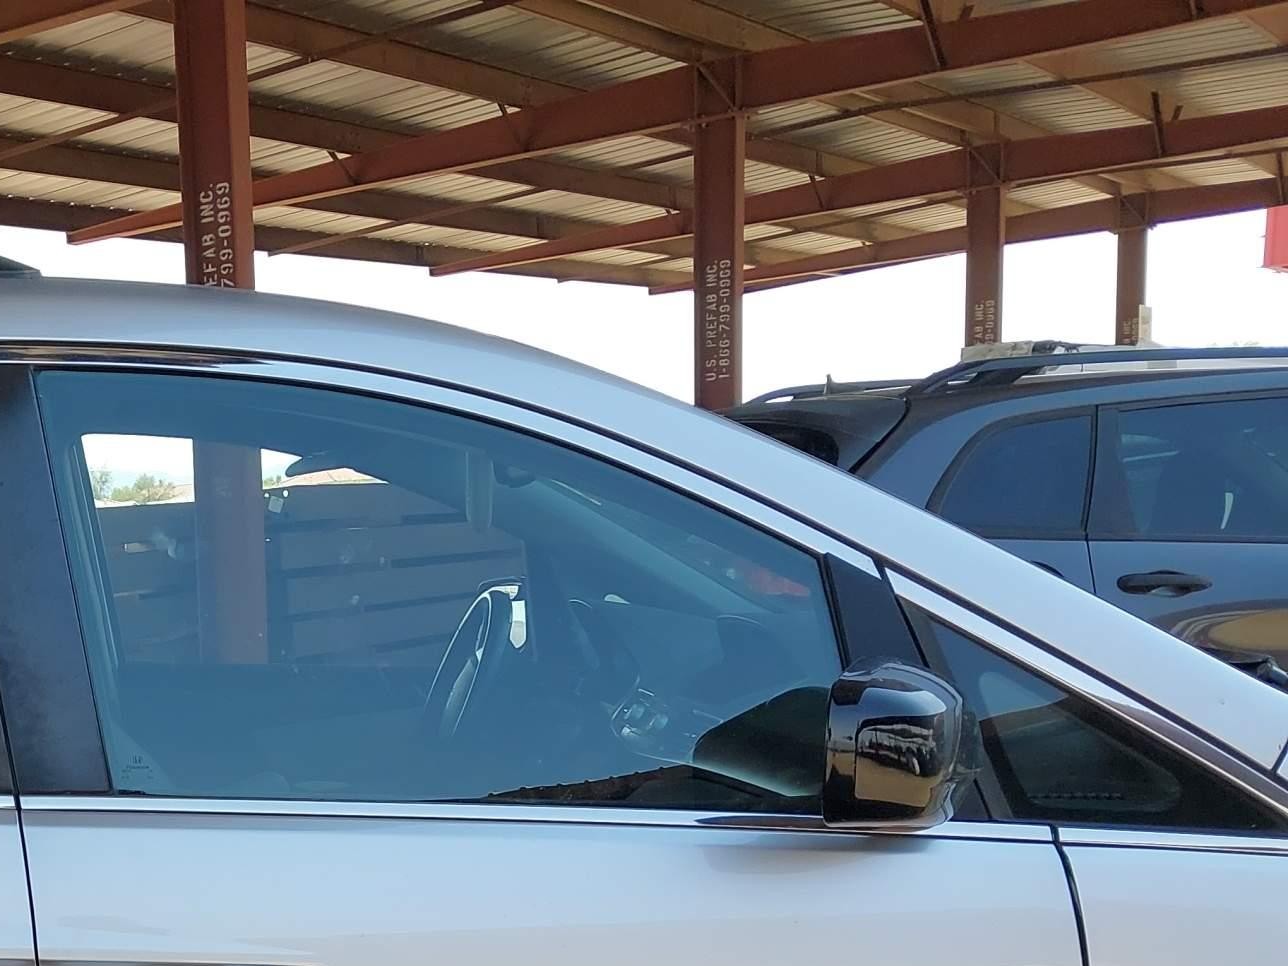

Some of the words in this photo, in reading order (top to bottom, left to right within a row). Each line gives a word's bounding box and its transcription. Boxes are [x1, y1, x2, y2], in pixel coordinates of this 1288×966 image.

[200, 183, 215, 224] INC.
[706, 259, 718, 287] INC.
[706, 294, 717, 348] PREFAB
[705, 354, 717, 382] U.S.
